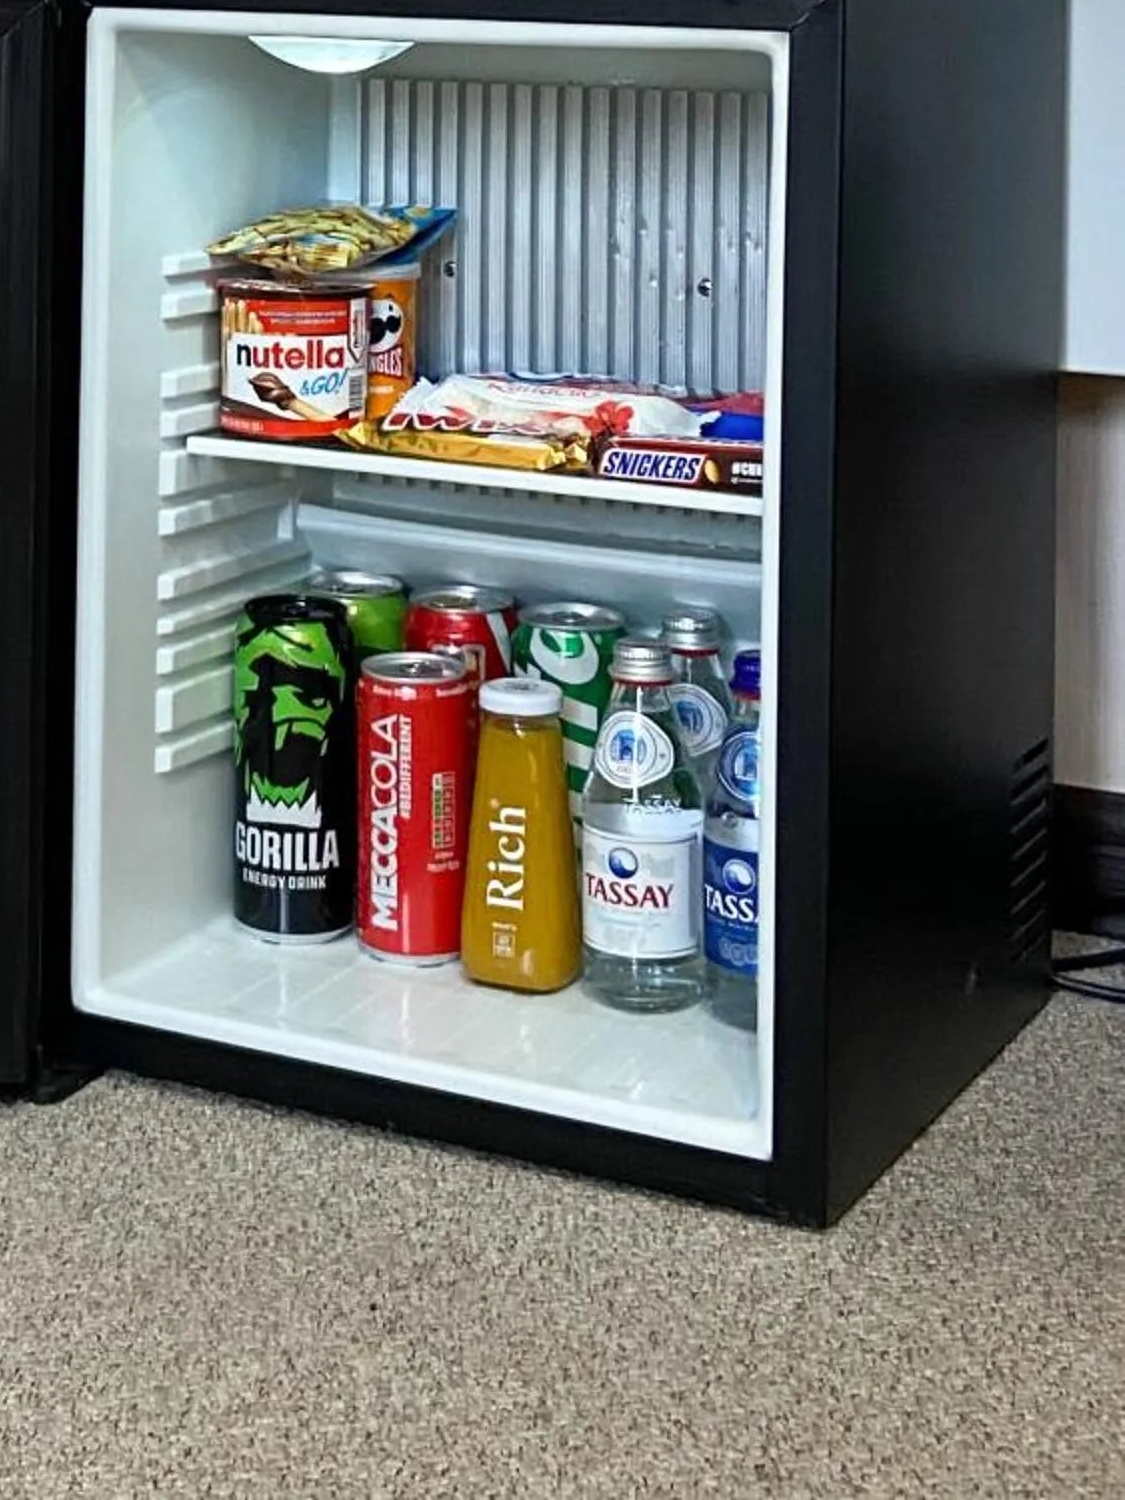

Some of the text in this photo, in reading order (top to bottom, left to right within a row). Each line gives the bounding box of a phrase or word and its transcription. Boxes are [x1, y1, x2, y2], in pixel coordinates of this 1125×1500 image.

[236, 339, 345, 370] nutella
[604, 451, 702, 481] SNICKERS
[370, 713, 400, 932] MECCACOLA
[235, 828, 340, 872] GORILLA
[486, 806, 527, 912] Rich
[242, 866, 327, 890] ENERGY DRINK
[584, 872, 674, 909] TASSAY
[704, 884, 759, 923] TASS
